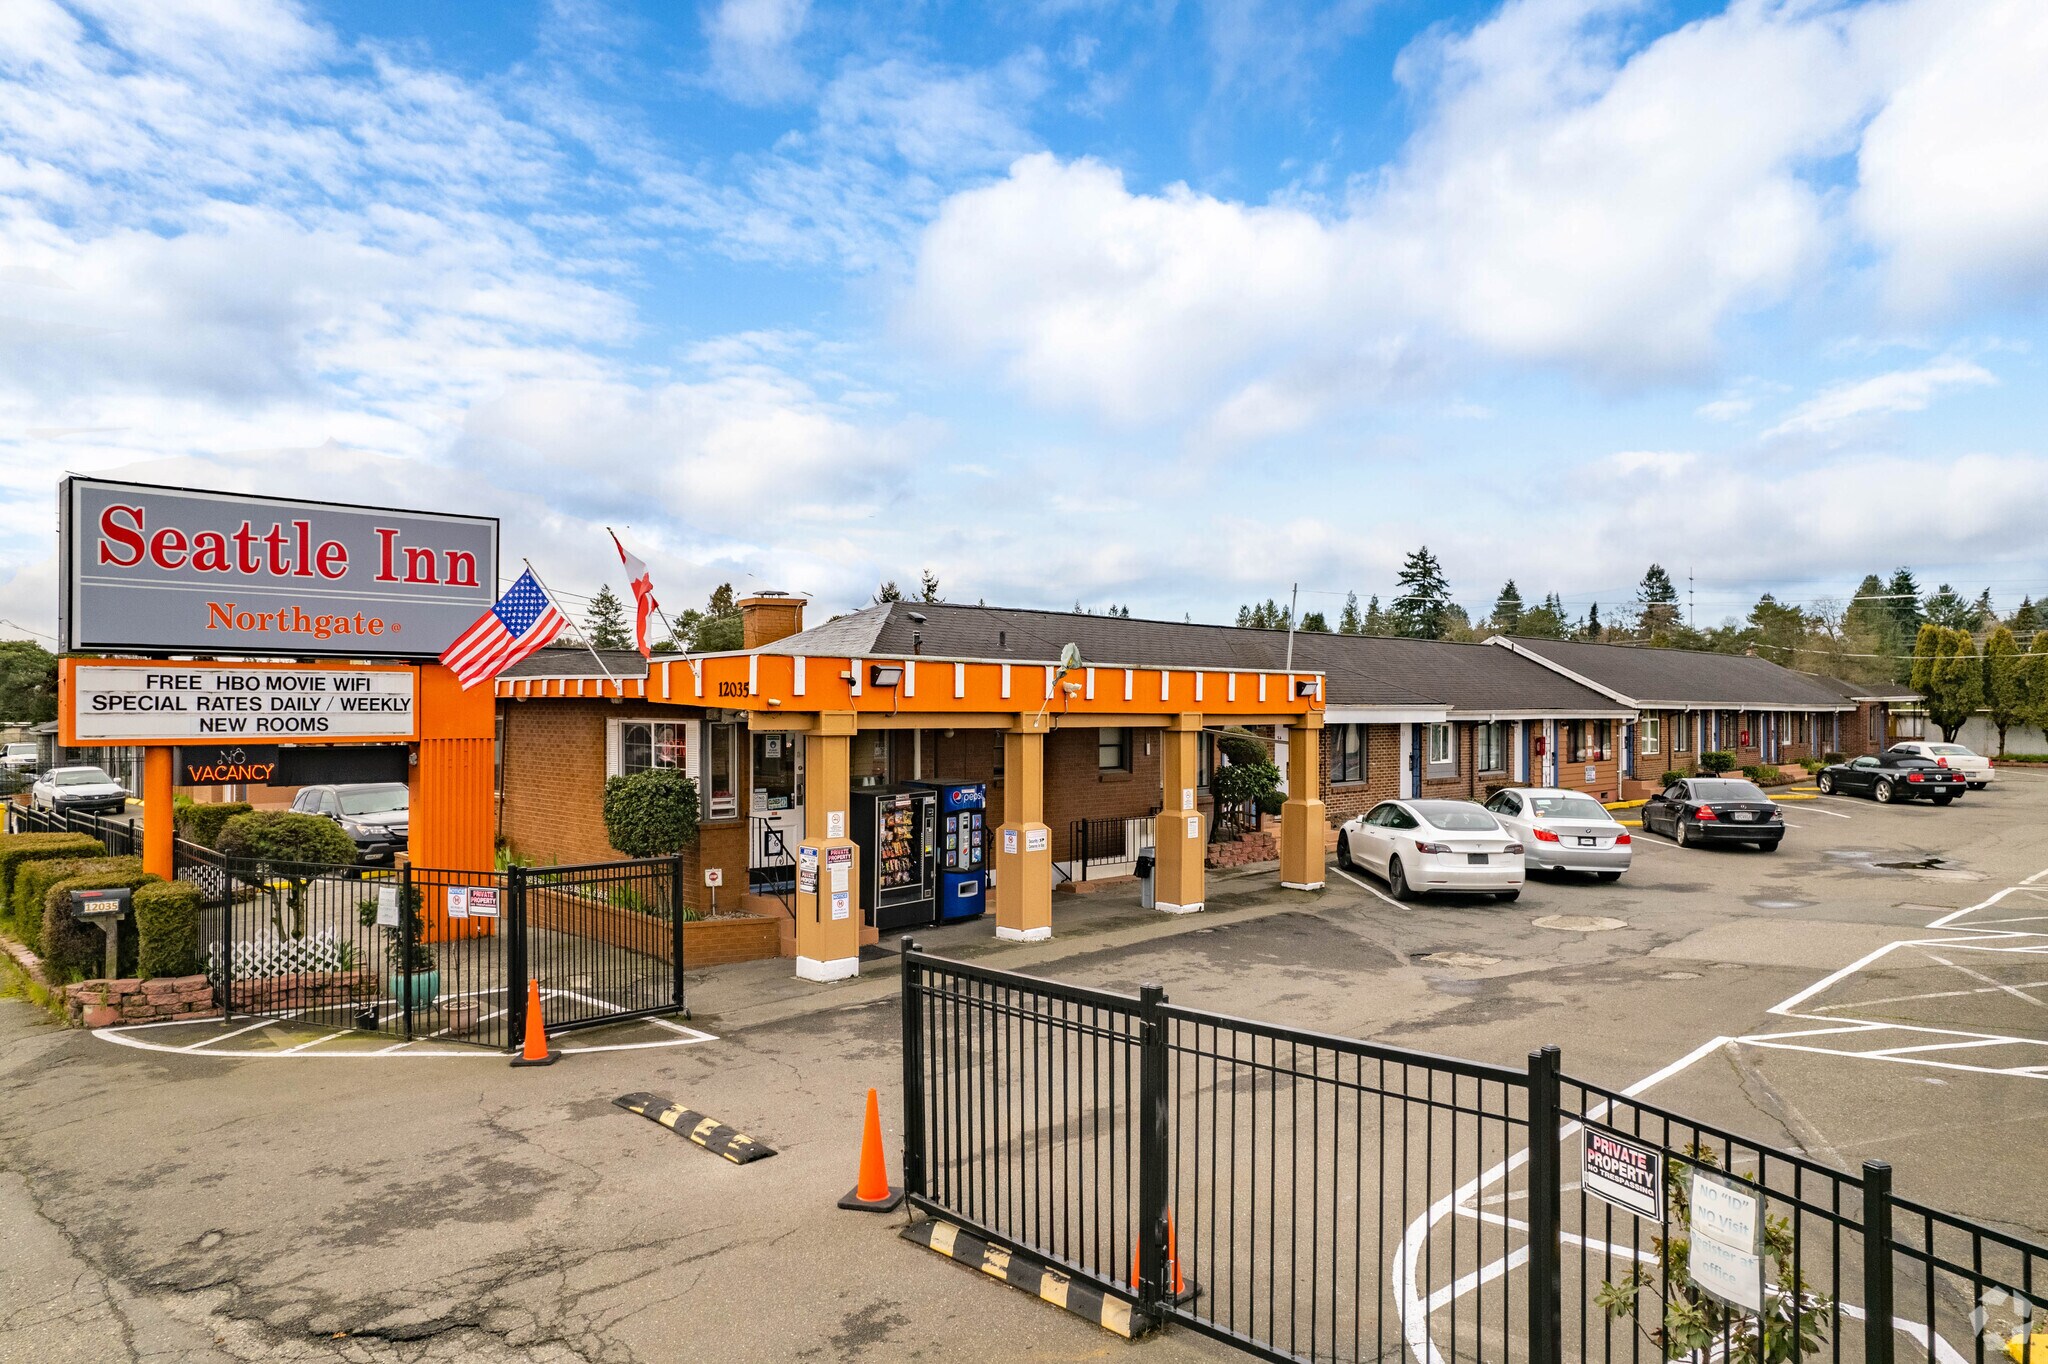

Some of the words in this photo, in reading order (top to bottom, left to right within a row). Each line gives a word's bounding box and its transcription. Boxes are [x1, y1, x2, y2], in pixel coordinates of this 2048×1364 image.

[98, 503, 348, 580] Seattle
[374, 527, 480, 588] Inn
[206, 601, 384, 640] Northgate
[146, 674, 202, 690] FREE
[216, 675, 261, 691] HBO
[266, 676, 326, 691] MOVIE
[333, 677, 371, 692] WIFI
[718, 681, 750, 698] 12035
[92, 694, 188, 711] SPECIAL
[196, 696, 262, 711] RATES
[270, 697, 321, 711] DAILY
[340, 697, 411, 712] WEEKLY
[199, 717, 247, 732] NEW
[256, 717, 329, 732] ROOMS
[217, 748, 246, 764] NO
[188, 763, 275, 782] VACANCY
[963, 791, 983, 803] pepsi
[828, 853, 852, 861] PROPERTY
[830, 848, 850, 856] PRIVATE
[470, 897, 496, 905] PROPERTY
[473, 890, 494, 898] PRIVATE
[85, 902, 118, 911] 12035
[1593, 1135, 1647, 1170] PRIVATE
[1587, 1148, 1654, 1188] PROPERTY
[1587, 1163, 1598, 1173] NO
[1600, 1169, 1655, 1197] TRESPASSING
[1700, 1184, 1717, 1201] NO
[1698, 1206, 1716, 1223] NO
[1719, 1214, 1749, 1237] Visit
[1691, 1230, 1736, 1262] Register
[1741, 1256, 1755, 1268] at
[1702, 1261, 1736, 1284] office
